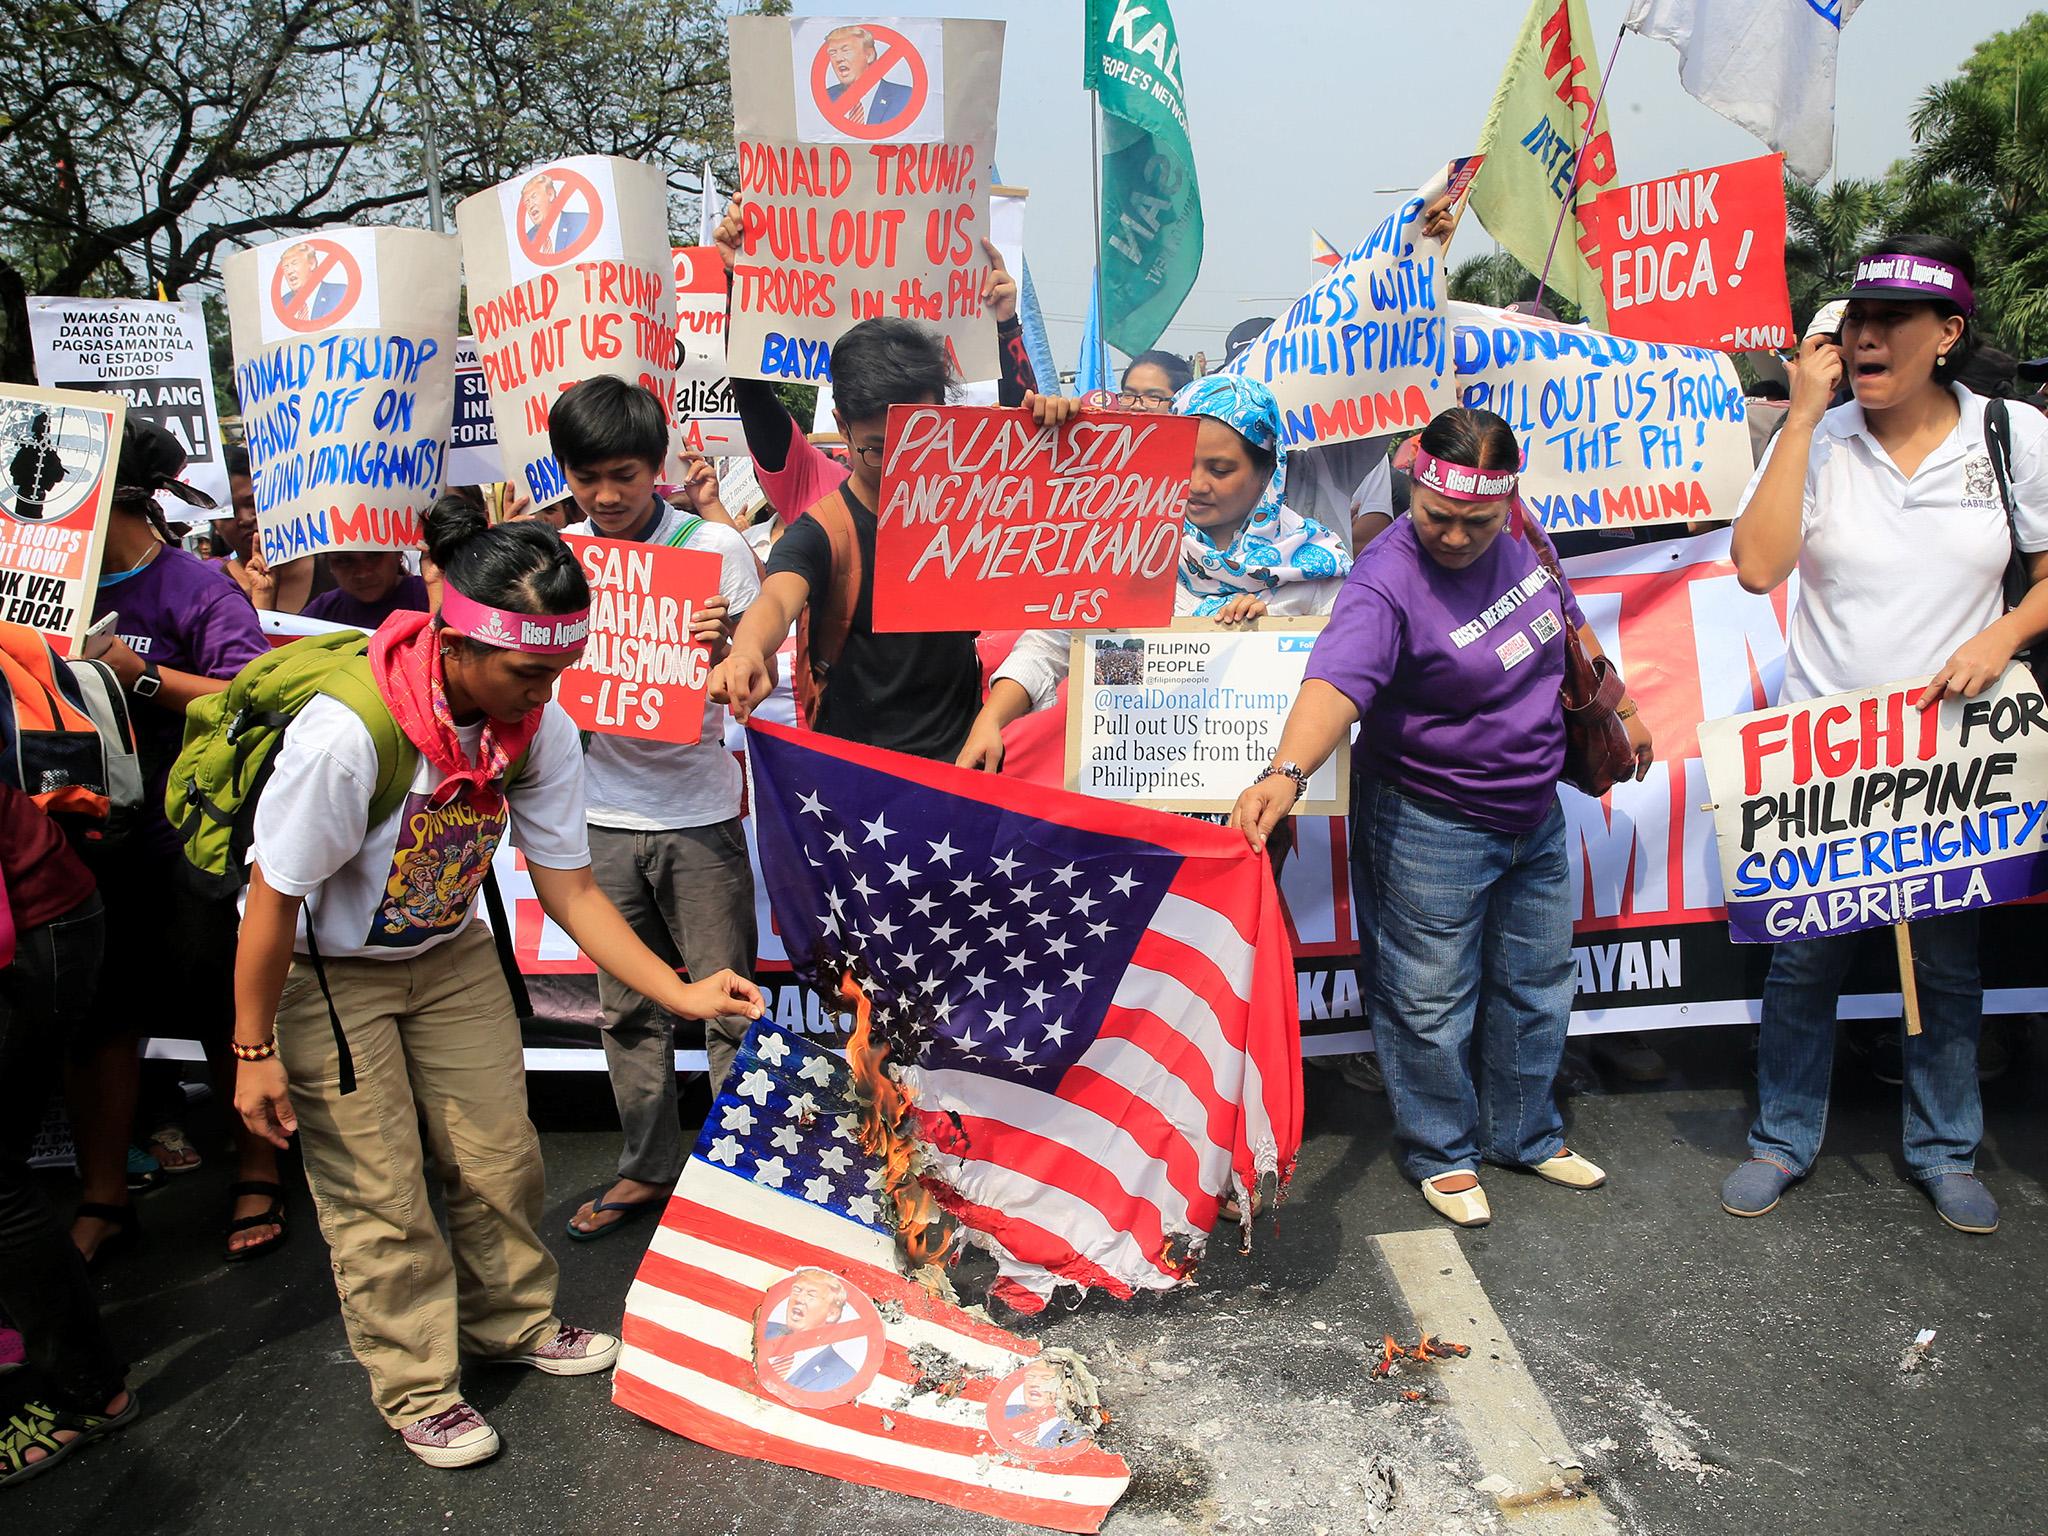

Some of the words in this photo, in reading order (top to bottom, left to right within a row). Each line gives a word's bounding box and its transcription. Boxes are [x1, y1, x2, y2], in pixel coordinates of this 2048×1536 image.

[1102, 54, 1152, 91] PEOPLE'S
[739, 141, 852, 199] DONALD
[869, 143, 977, 200] TRUMP,
[1617, 172, 1719, 241] JUNK
[925, 203, 976, 267] US
[732, 264, 836, 319] TROOPS
[850, 288, 884, 320] IN
[947, 264, 988, 319] PH!
[1369, 255, 1436, 314] WITH
[1866, 259, 1895, 282] Against
[1894, 259, 1911, 280] U.S.
[1910, 260, 1954, 290] Imperialism
[60, 325, 114, 339] DAANG
[118, 326, 158, 338] TAON
[163, 327, 183, 338] NA
[63, 311, 140, 325] WAKASAN
[147, 312, 176, 325] ANG
[473, 273, 559, 344] DONALD
[52, 339, 194, 353] PAGSASAMANTALA
[79, 352, 103, 365] NG
[106, 351, 174, 365] ESTADOS
[482, 338, 527, 398] PULL
[532, 319, 571, 378] OUT
[580, 312, 622, 360] US
[629, 312, 677, 371] TROOPS
[1264, 317, 1446, 390] PHILIPPINES!
[1453, 324, 1638, 376] DONALD
[98, 365, 160, 379] UNIDOS!
[157, 386, 202, 407] ANG
[238, 342, 317, 412] DONALD
[319, 334, 438, 385] TRUMP
[524, 391, 550, 436] IN
[1311, 385, 1431, 441] MUNA
[1540, 372, 1603, 429] OUT
[1613, 371, 1656, 423] US
[1661, 367, 1745, 424] TROOPS
[245, 394, 301, 469] HANDS
[308, 386, 366, 438] OFF
[373, 388, 416, 433] ON
[885, 409, 1157, 476] PALAYASIN
[1545, 423, 1623, 473] THE
[252, 453, 304, 514] FILIPINO
[306, 437, 446, 500] IMMIGRANTS!
[1445, 468, 1477, 493] Rise!
[878, 474, 962, 528] ANG
[957, 474, 1033, 521] MGA
[1046, 474, 1190, 520] TROPANG
[1602, 480, 1712, 525] MUNA
[11, 523, 82, 553] TROOPS
[17, 547, 69, 574] NOW!
[264, 509, 330, 563] BAYAN
[907, 520, 1179, 583] AMERIKANO
[6, 598, 74, 632] EDCA!
[26, 575, 66, 605] VFA
[521, 621, 551, 645] Rise
[1448, 618, 1487, 649] RISE!
[1480, 586, 1527, 630] RESIST!
[1147, 643, 1211, 655] FILIPINO
[1147, 661, 1205, 673] PEOPLE
[580, 679, 664, 731] -LFS
[1094, 689, 1289, 714] @realDonaldTrump
[1146, 676, 1210, 684] @filipinopeople
[1092, 740, 1127, 761] and
[1134, 740, 1187, 761] bases
[1193, 741, 1240, 761] from
[1246, 742, 1277, 761] the
[1094, 714, 1129, 735] Pull
[1135, 718, 1167, 735] out
[1173, 715, 1198, 735] US
[1204, 718, 1269, 741] troops
[1739, 687, 1944, 796] FIGHT
[1960, 692, 2048, 748] FOR
[1092, 766, 1205, 792] Philippines.
[1741, 752, 2018, 852] PHILIPPINE
[1765, 867, 1992, 937] GABRIELA
